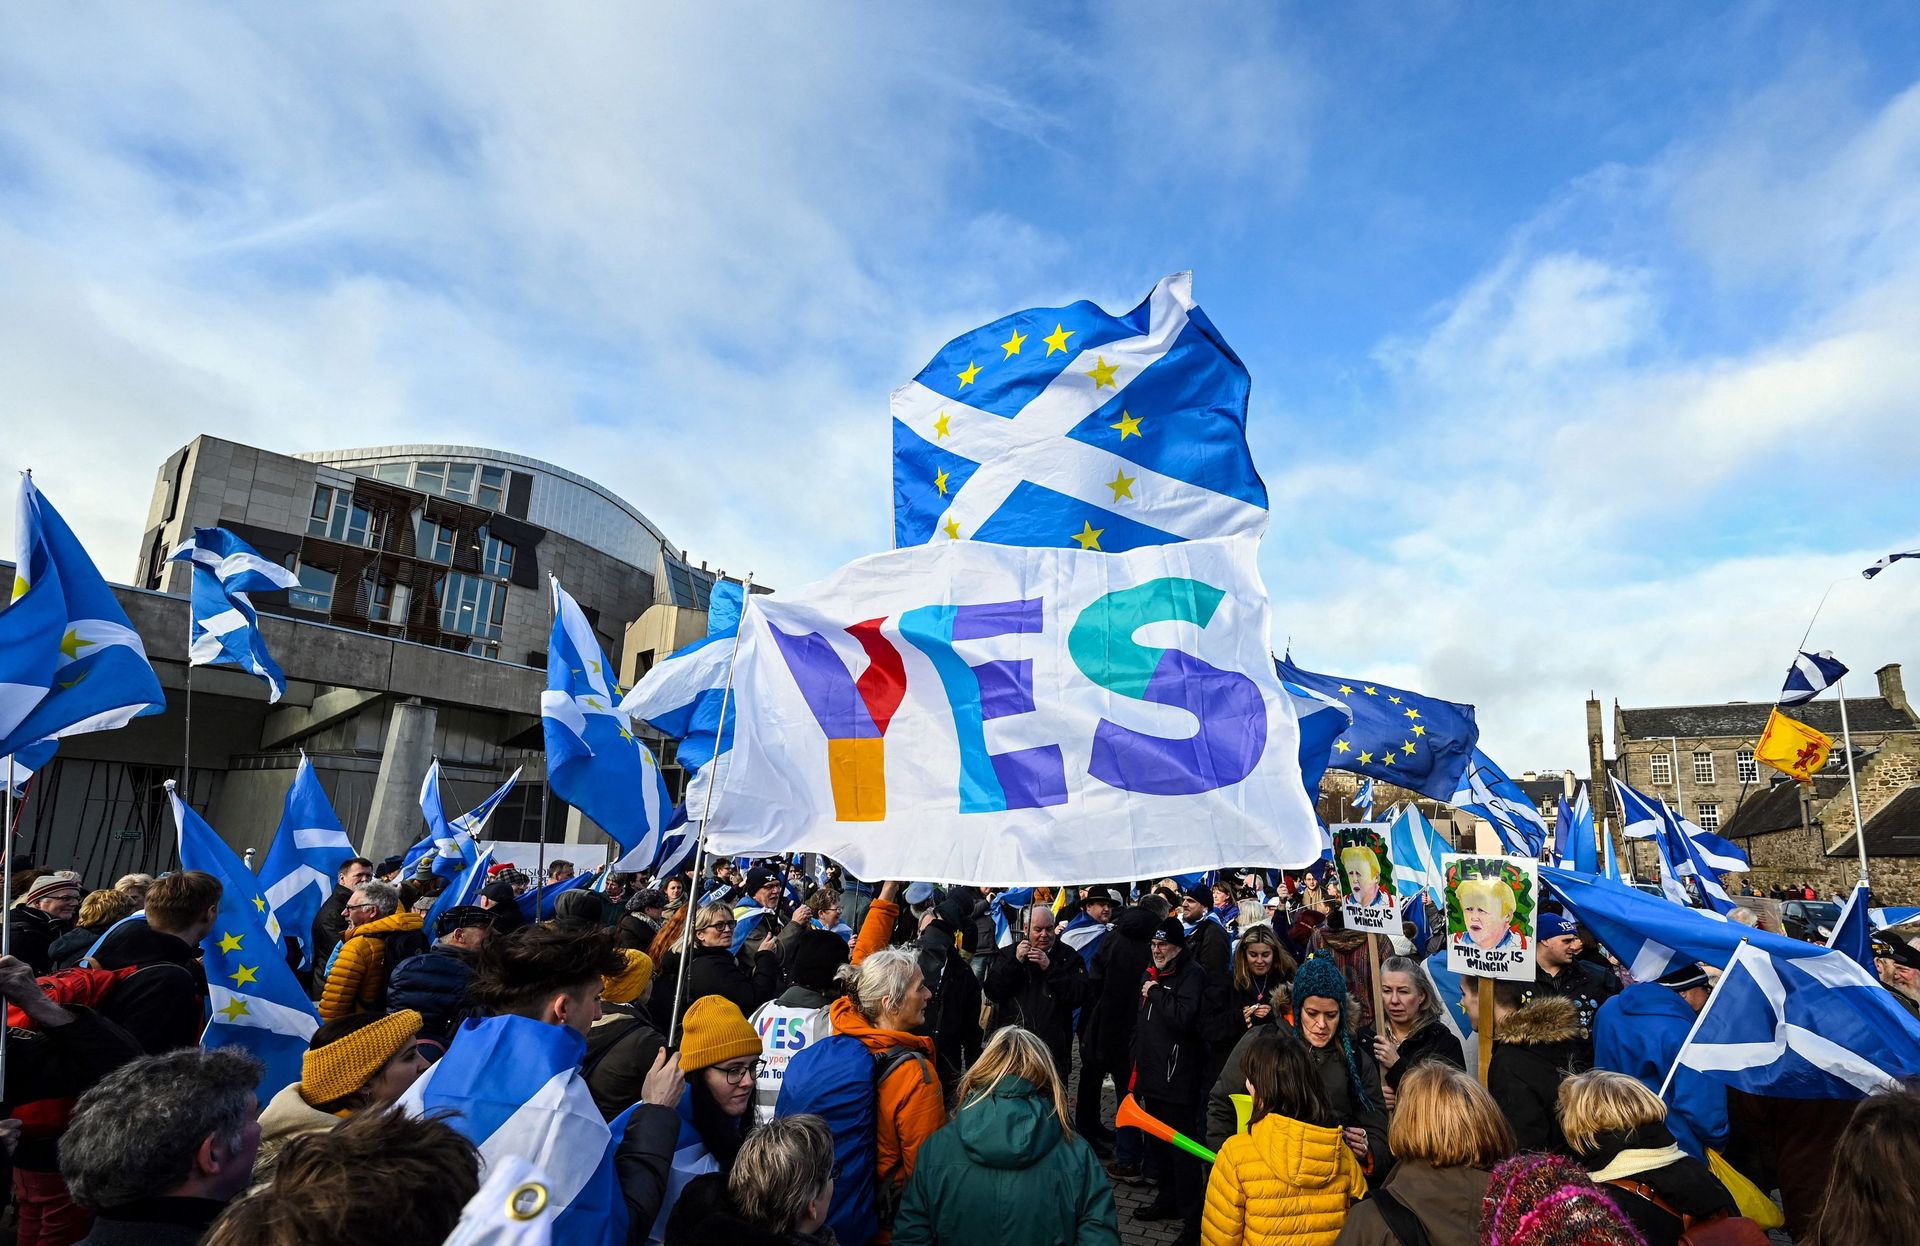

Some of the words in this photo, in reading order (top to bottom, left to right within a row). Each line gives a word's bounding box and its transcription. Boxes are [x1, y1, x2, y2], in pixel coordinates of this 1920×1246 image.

[766, 577, 1267, 821] YES
[1346, 906, 1362, 916] THIS
[1364, 908, 1380, 918] GUY
[1383, 909, 1393, 920] IS
[1454, 945, 1481, 959] THIS
[1485, 951, 1507, 962] GUY
[1511, 951, 1524, 963] IS
[1466, 958, 1510, 972] MINGIN'
[759, 1017, 805, 1050] YES
